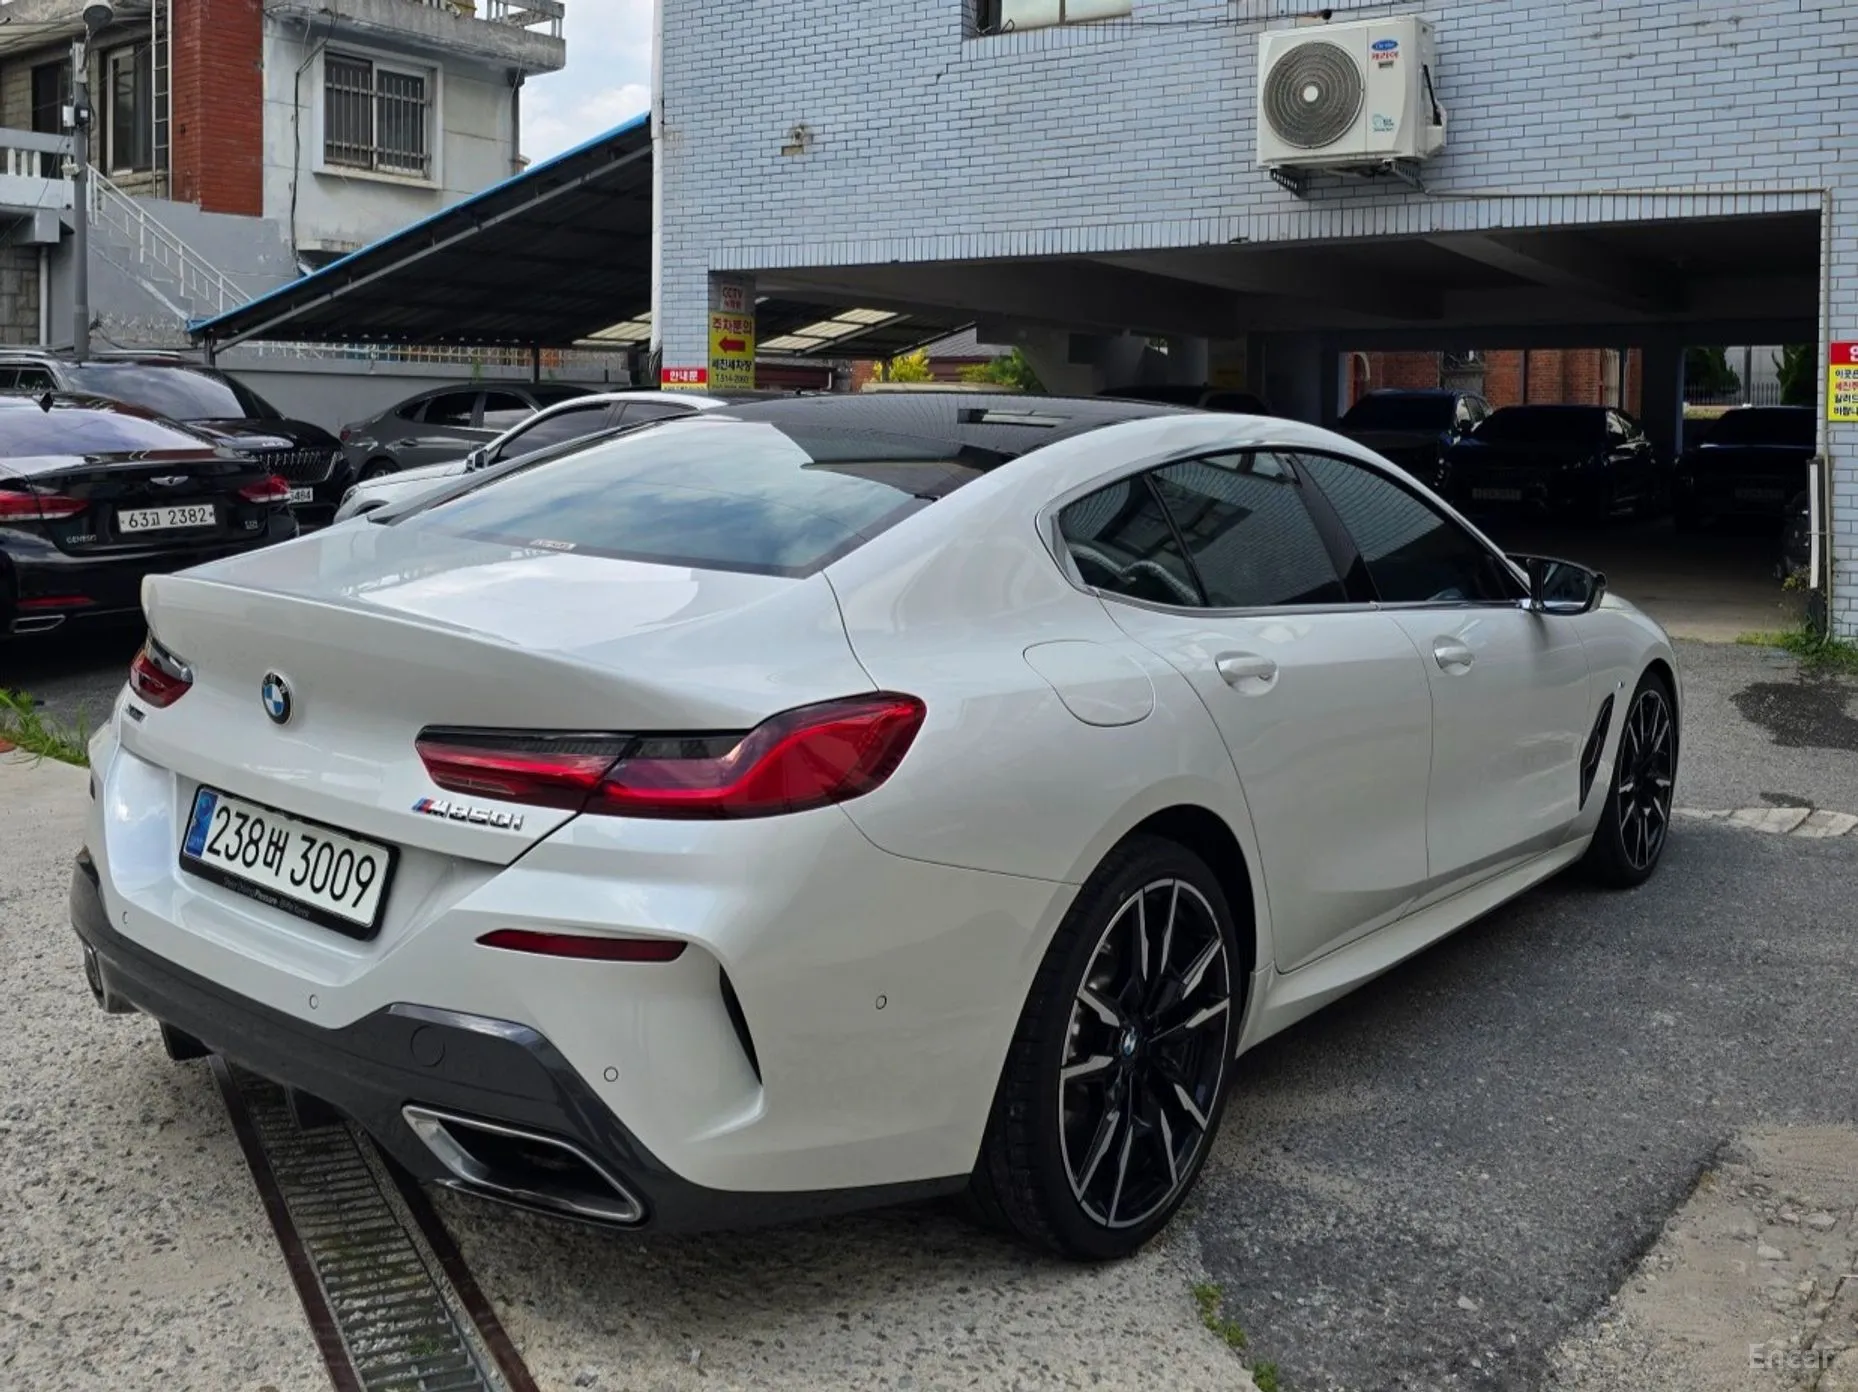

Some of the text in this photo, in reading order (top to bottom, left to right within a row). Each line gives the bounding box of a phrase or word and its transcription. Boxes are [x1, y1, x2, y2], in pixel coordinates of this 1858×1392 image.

[722, 286, 743, 298] CCTV
[712, 316, 752, 336] 주차문의
[168, 507, 207, 525] 2382
[207, 806, 376, 908] 238버 3009
